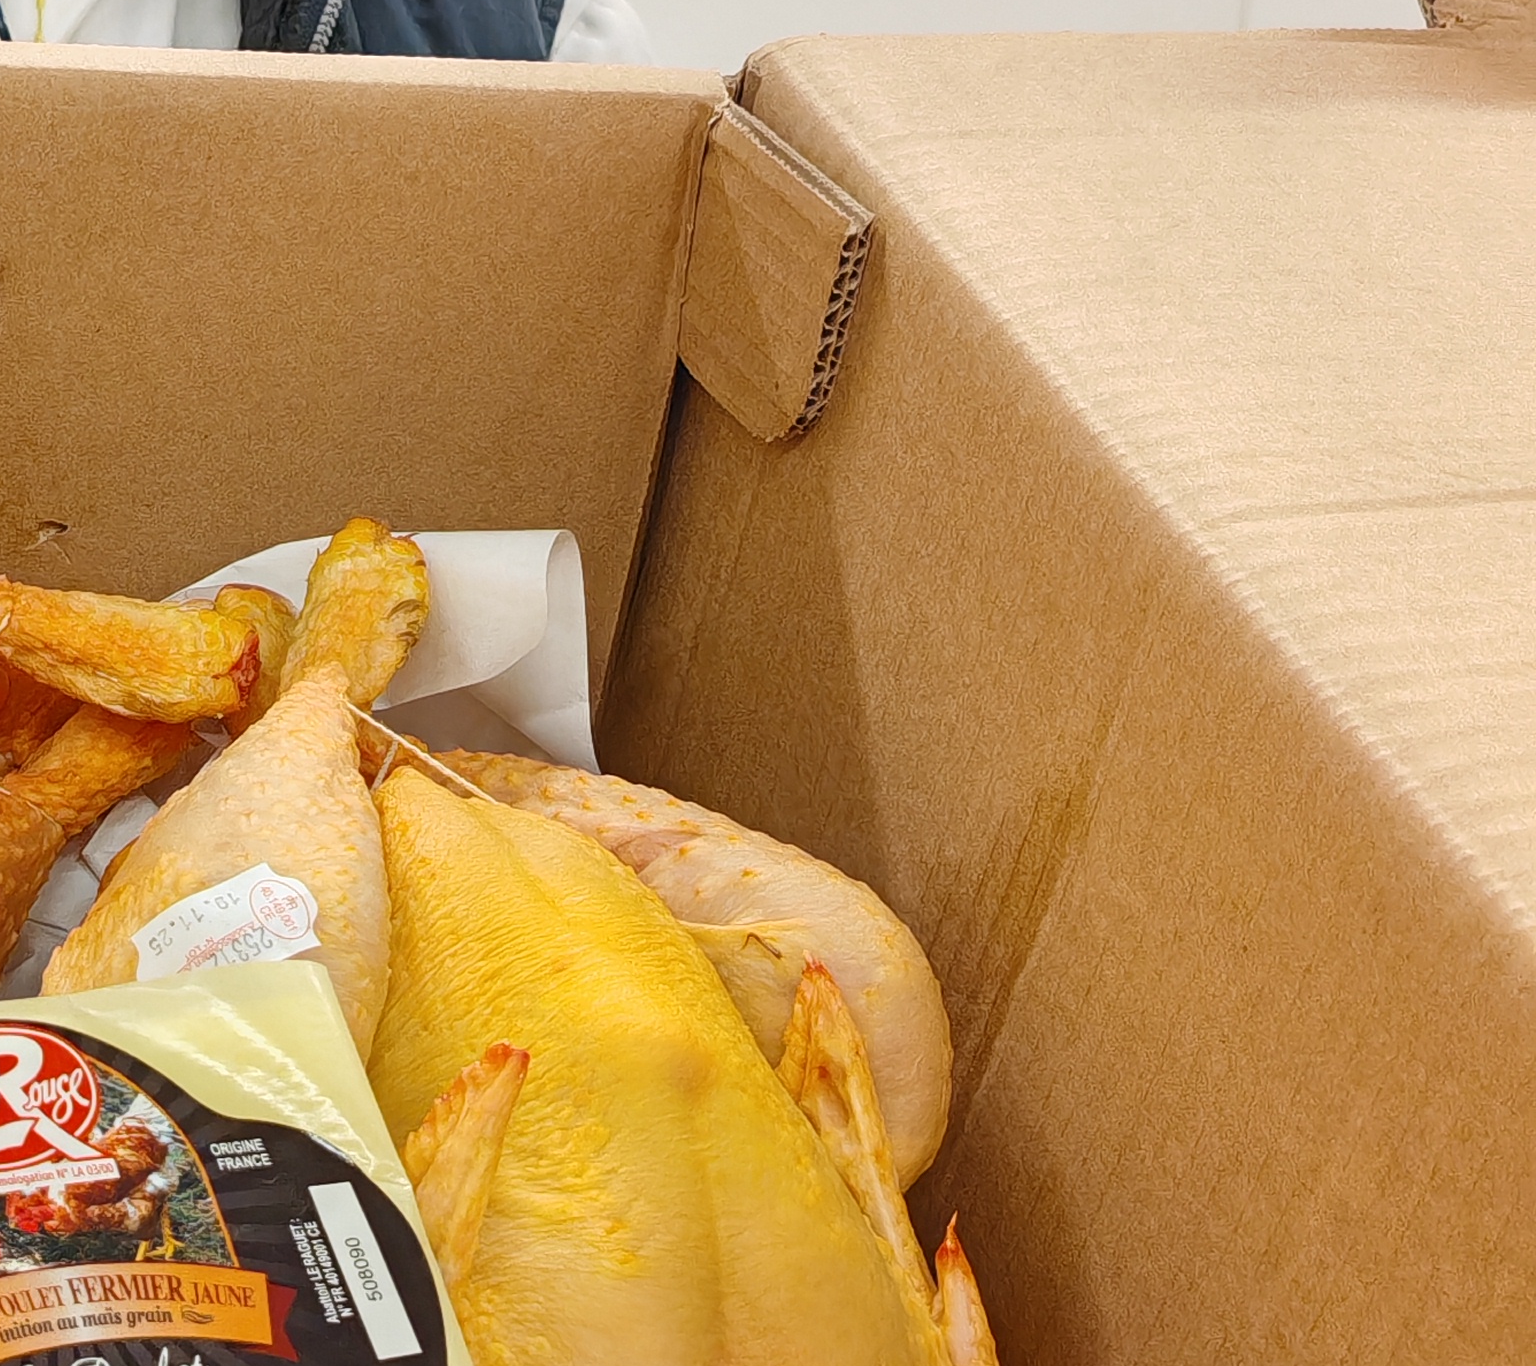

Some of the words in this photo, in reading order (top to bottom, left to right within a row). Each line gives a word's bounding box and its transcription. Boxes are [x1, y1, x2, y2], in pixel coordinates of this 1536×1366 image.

[210, 1138, 266, 1156] ORIGINE
[71, 1165, 86, 1177] LA
[216, 1153, 273, 1171] FRANCE
[304, 1221, 321, 1237] CE
[311, 1239, 339, 1285] 40149001
[345, 1237, 383, 1301] 508090
[306, 1266, 323, 1281] LE
[66, 1273, 186, 1305] FERMIER
[190, 1281, 256, 1308] JAUNE
[331, 1286, 348, 1303] FR
[314, 1282, 340, 1324] Abattoir
[57, 1315, 79, 1330] au
[82, 1307, 123, 1328] maïs
[128, 1305, 173, 1329] grain
